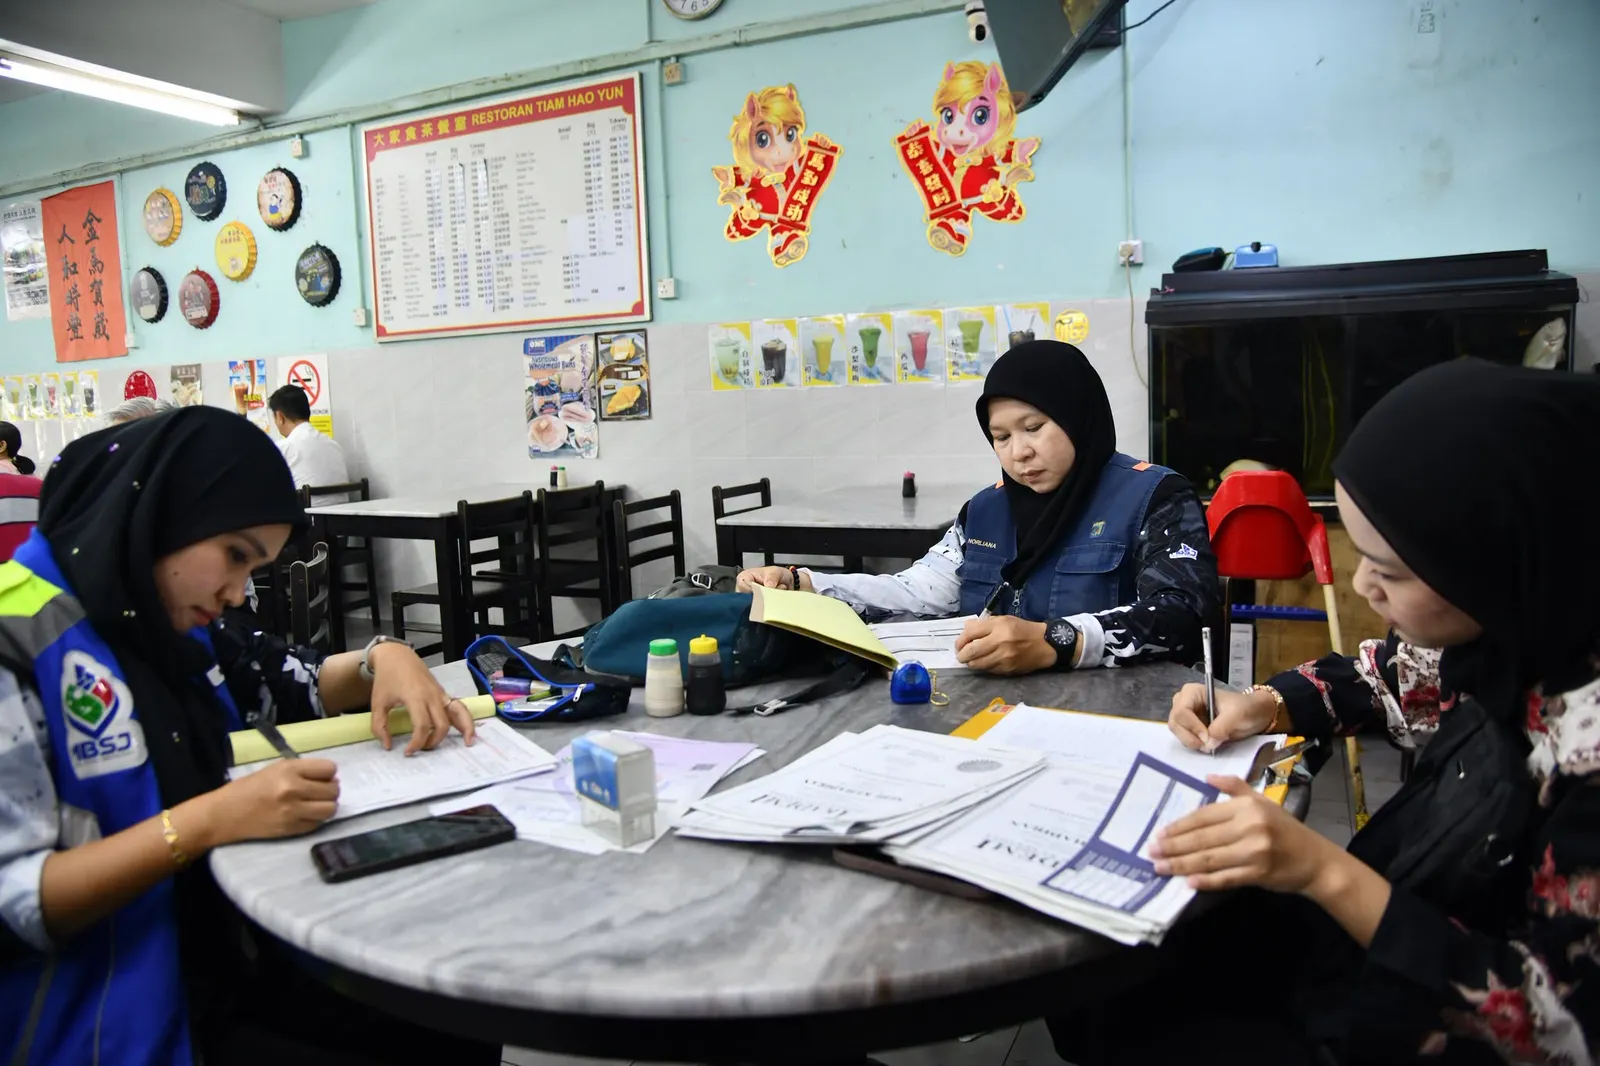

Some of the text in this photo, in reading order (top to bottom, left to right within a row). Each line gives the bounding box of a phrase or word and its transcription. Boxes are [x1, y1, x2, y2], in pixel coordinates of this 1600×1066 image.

[471, 86, 624, 126] RESTORAN TIAM HAO YUN
[786, 152, 826, 221] 馬到成功
[906, 141, 951, 207] 恭喜發財
[967, 537, 997, 549] NORLIANA
